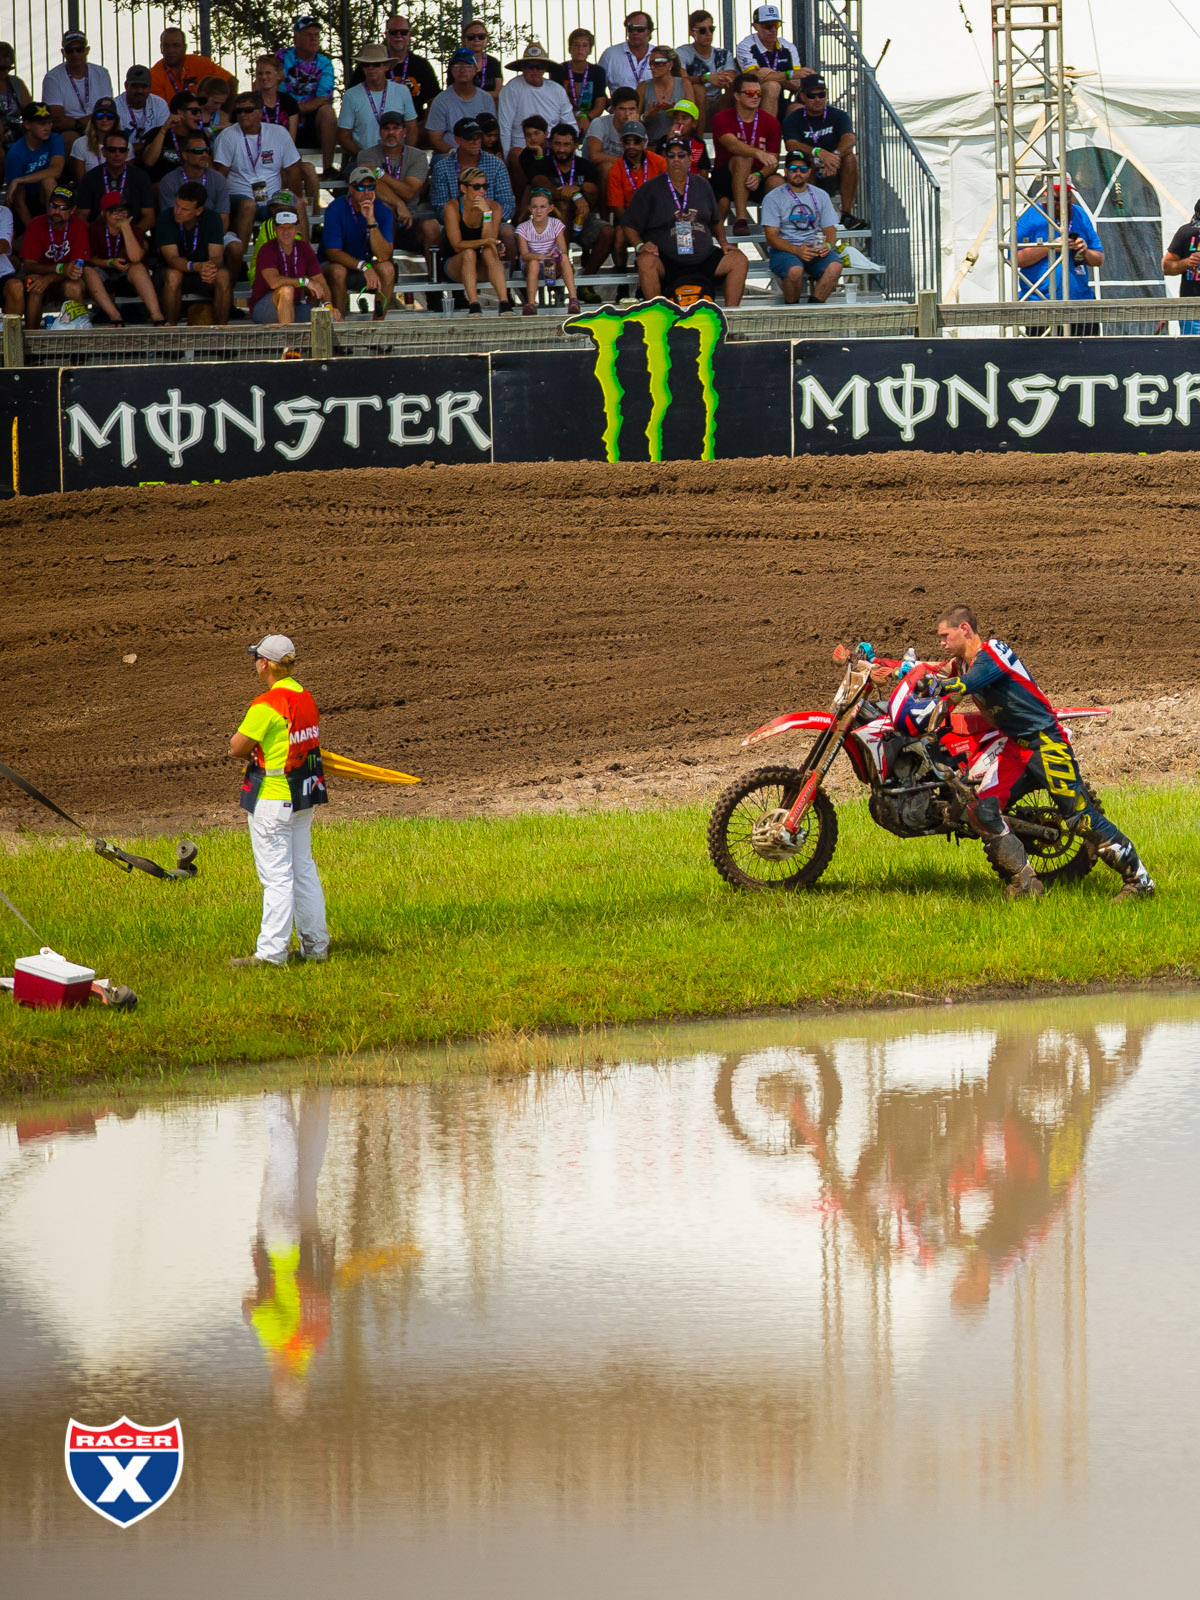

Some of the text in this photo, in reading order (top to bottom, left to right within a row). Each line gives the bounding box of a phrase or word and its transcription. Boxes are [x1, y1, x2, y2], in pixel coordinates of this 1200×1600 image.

[65, 385, 492, 468] MONSTER
[289, 724, 319, 745] MARS
[1038, 730, 1077, 798] FOX
